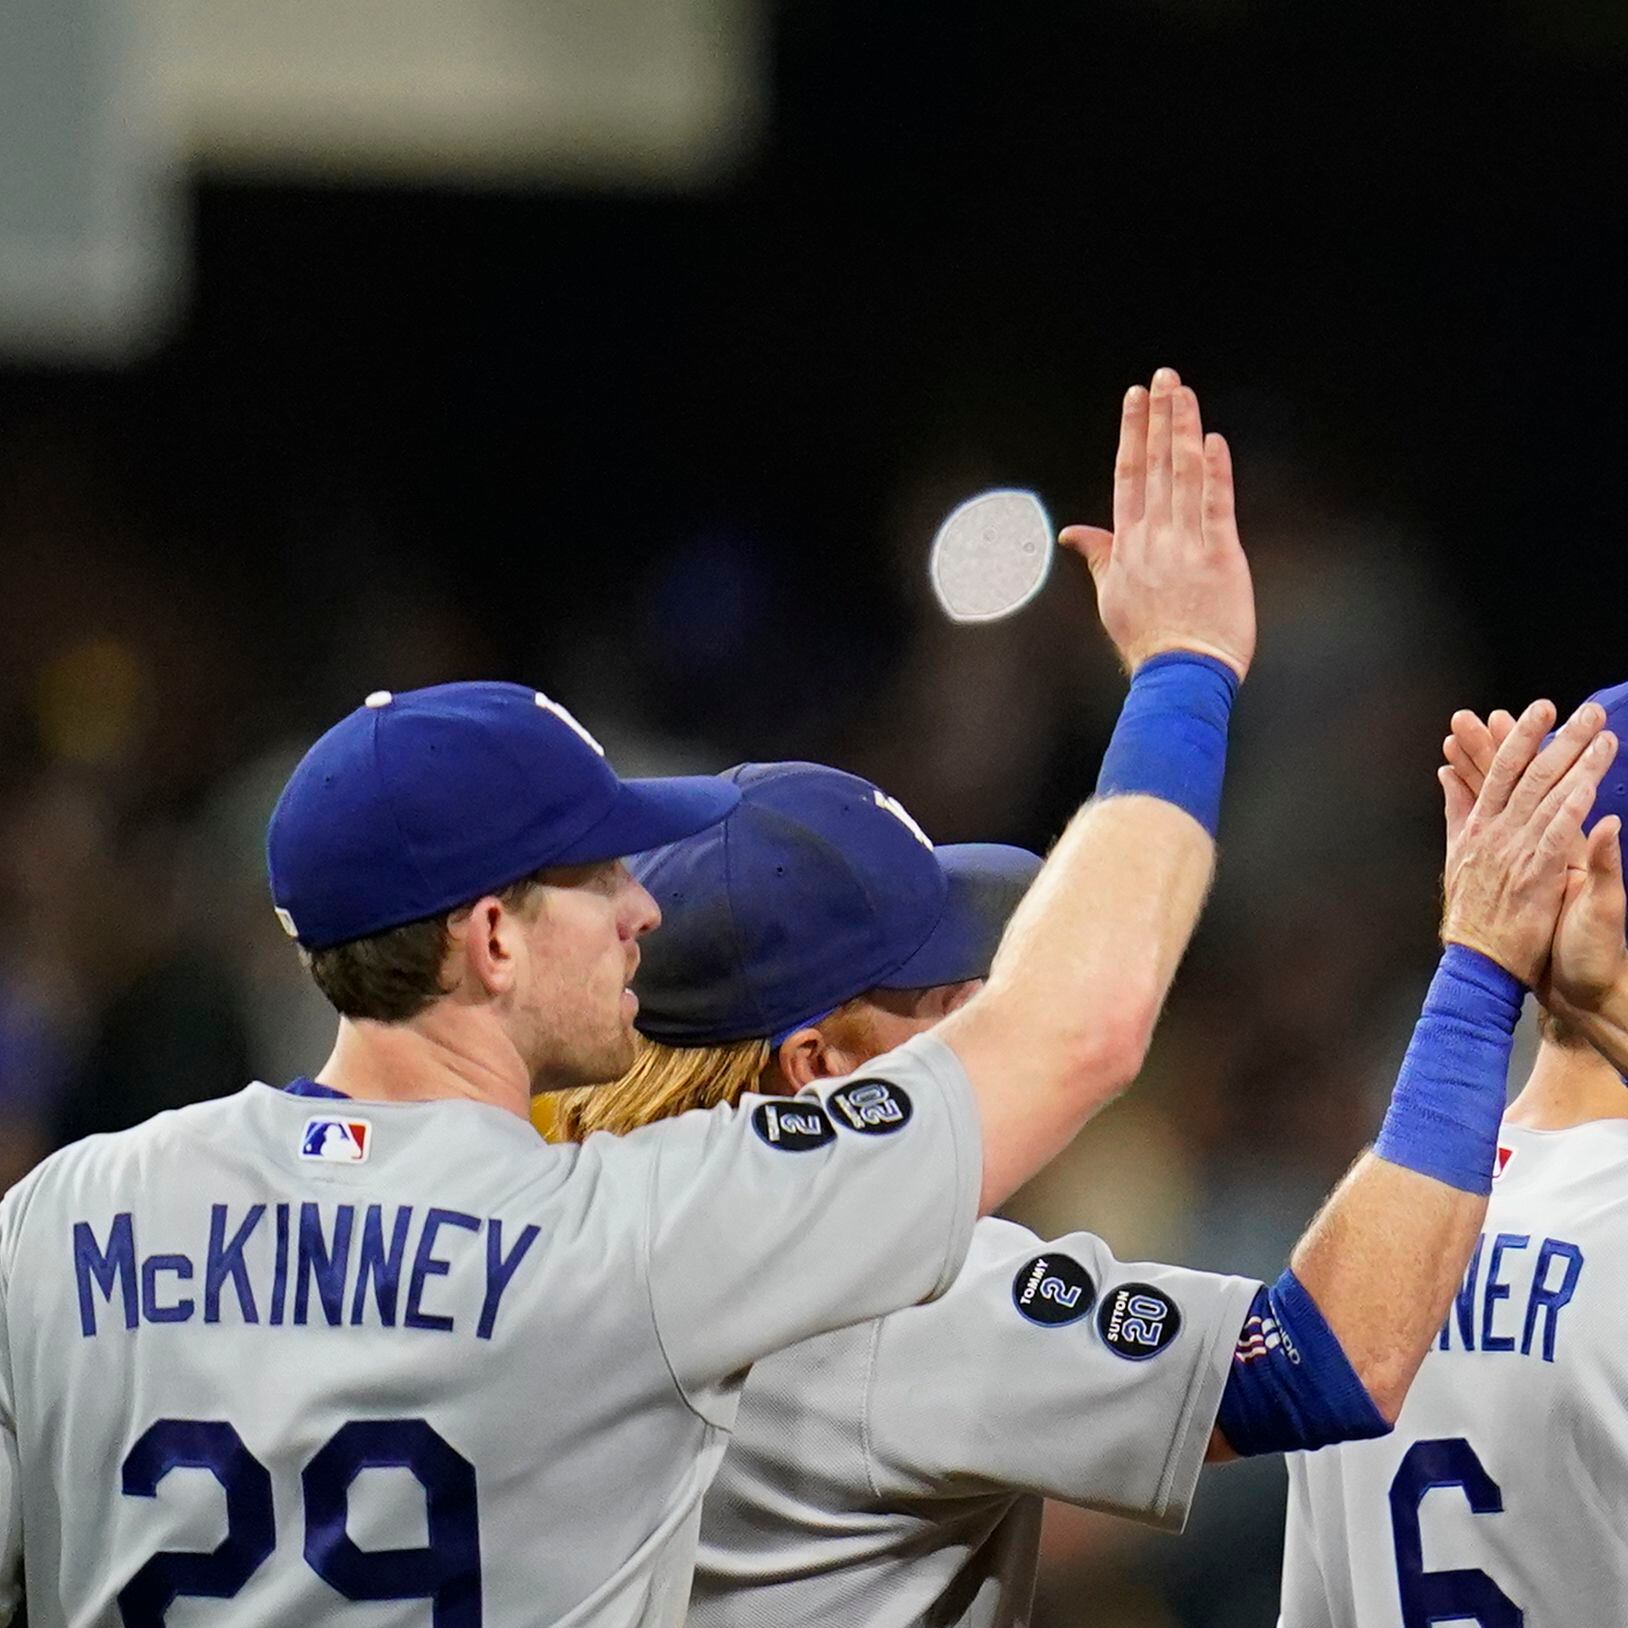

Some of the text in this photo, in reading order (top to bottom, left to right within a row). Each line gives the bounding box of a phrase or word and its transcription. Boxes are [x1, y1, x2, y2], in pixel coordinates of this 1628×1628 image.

[73, 1203, 541, 1340] McKINNEY
[1020, 1258, 1049, 1305] TOMMY
[1040, 1277, 1082, 1308] 2
[1438, 1232, 1585, 1363] NER
[1107, 1290, 1130, 1342] SUTTON
[1121, 1294, 1168, 1346] 20
